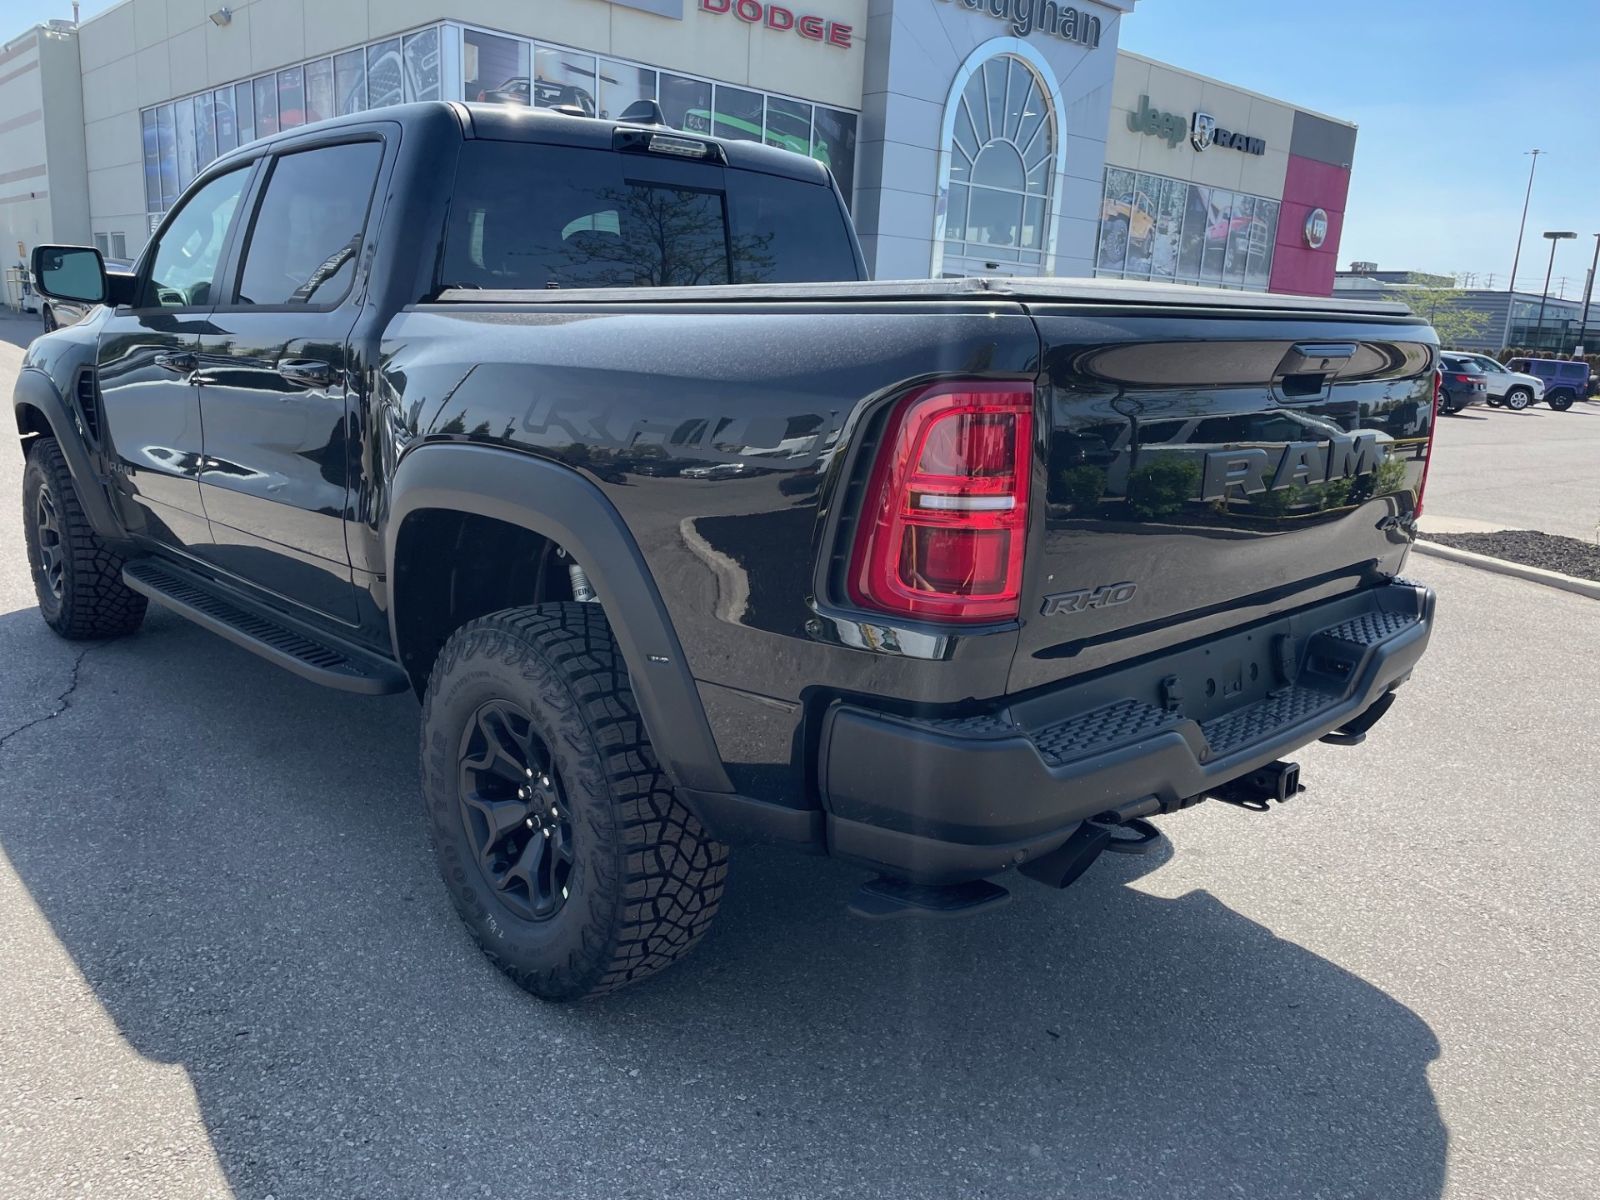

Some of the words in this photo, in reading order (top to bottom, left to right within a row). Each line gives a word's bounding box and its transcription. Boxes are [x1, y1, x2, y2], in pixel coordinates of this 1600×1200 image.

[698, 0, 853, 49] DODGE
[1127, 94, 1187, 148] Jeep
[1214, 128, 1266, 156] RAM
[109, 461, 136, 476] RAM
[1201, 434, 1377, 501] RAM
[1039, 581, 1137, 616] RHO
